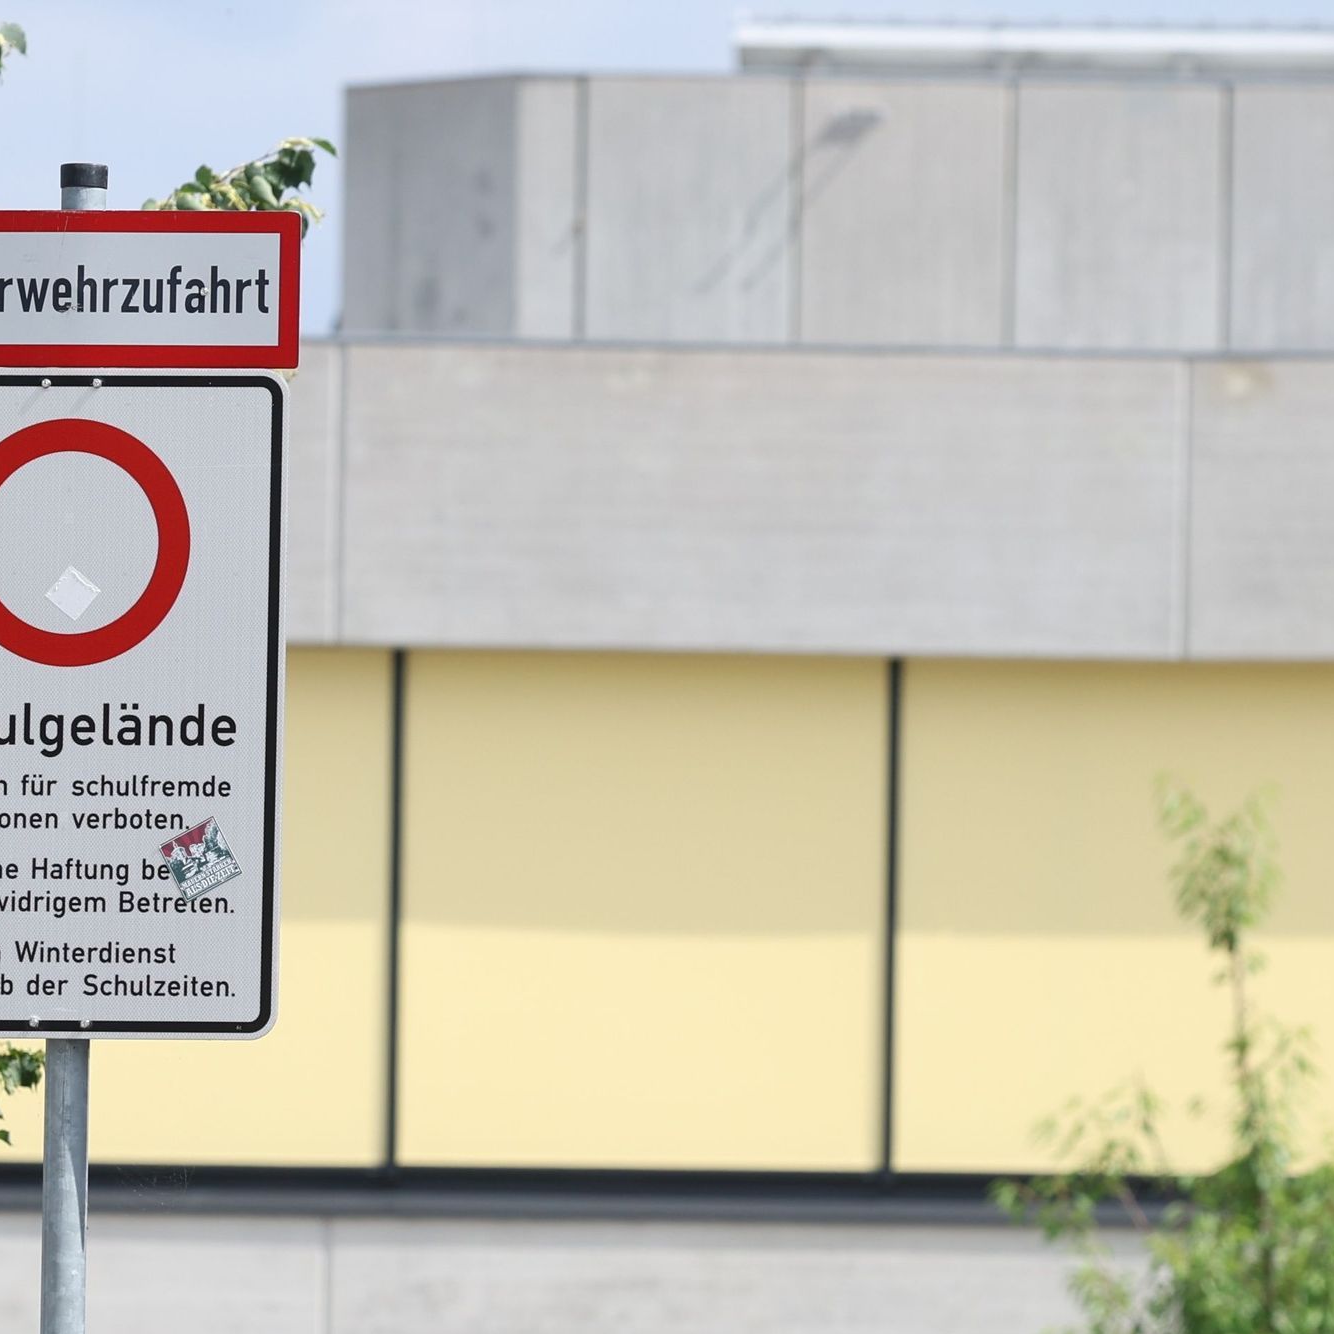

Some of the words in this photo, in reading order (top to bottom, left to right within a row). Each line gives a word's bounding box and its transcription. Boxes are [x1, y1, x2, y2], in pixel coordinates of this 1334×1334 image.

[21, 774, 58, 796] für
[71, 774, 231, 798] schulfremde
[72, 807, 191, 831] verboten.
[31, 857, 129, 886] Haftung
[141, 860, 170, 881] be
[14, 940, 176, 964] Winterdienst
[26, 973, 69, 996] der
[83, 973, 236, 997] Schulzeiten.
